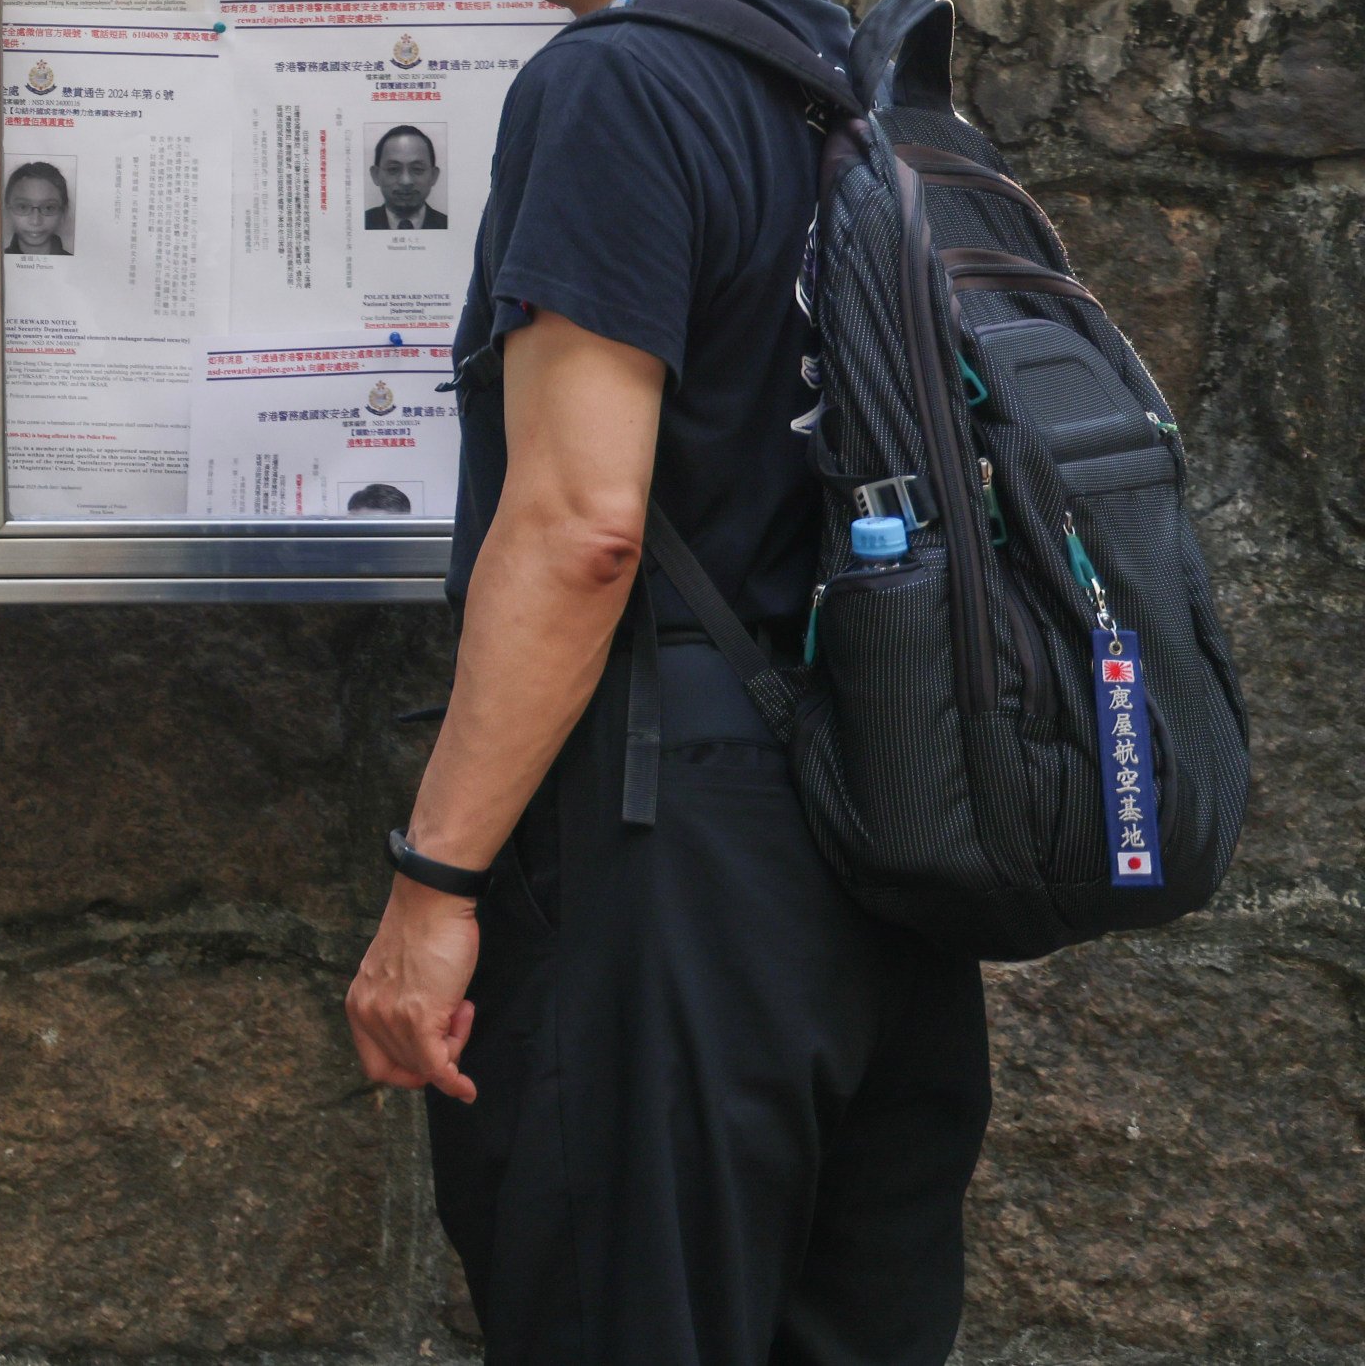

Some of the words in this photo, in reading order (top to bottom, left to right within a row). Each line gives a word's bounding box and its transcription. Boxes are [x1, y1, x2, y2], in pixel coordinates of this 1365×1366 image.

[428, 60, 471, 70] 懸賞通告
[474, 61, 494, 69] 2024
[498, 59, 518, 69] 年第
[62, 87, 105, 98] 懸賞通告
[108, 89, 128, 98] 2024
[131, 89, 152, 99] 年第
[155, 91, 160, 99] 6
[163, 90, 174, 100] 號
[1109, 685, 1146, 849] 鹿屋航空基地
